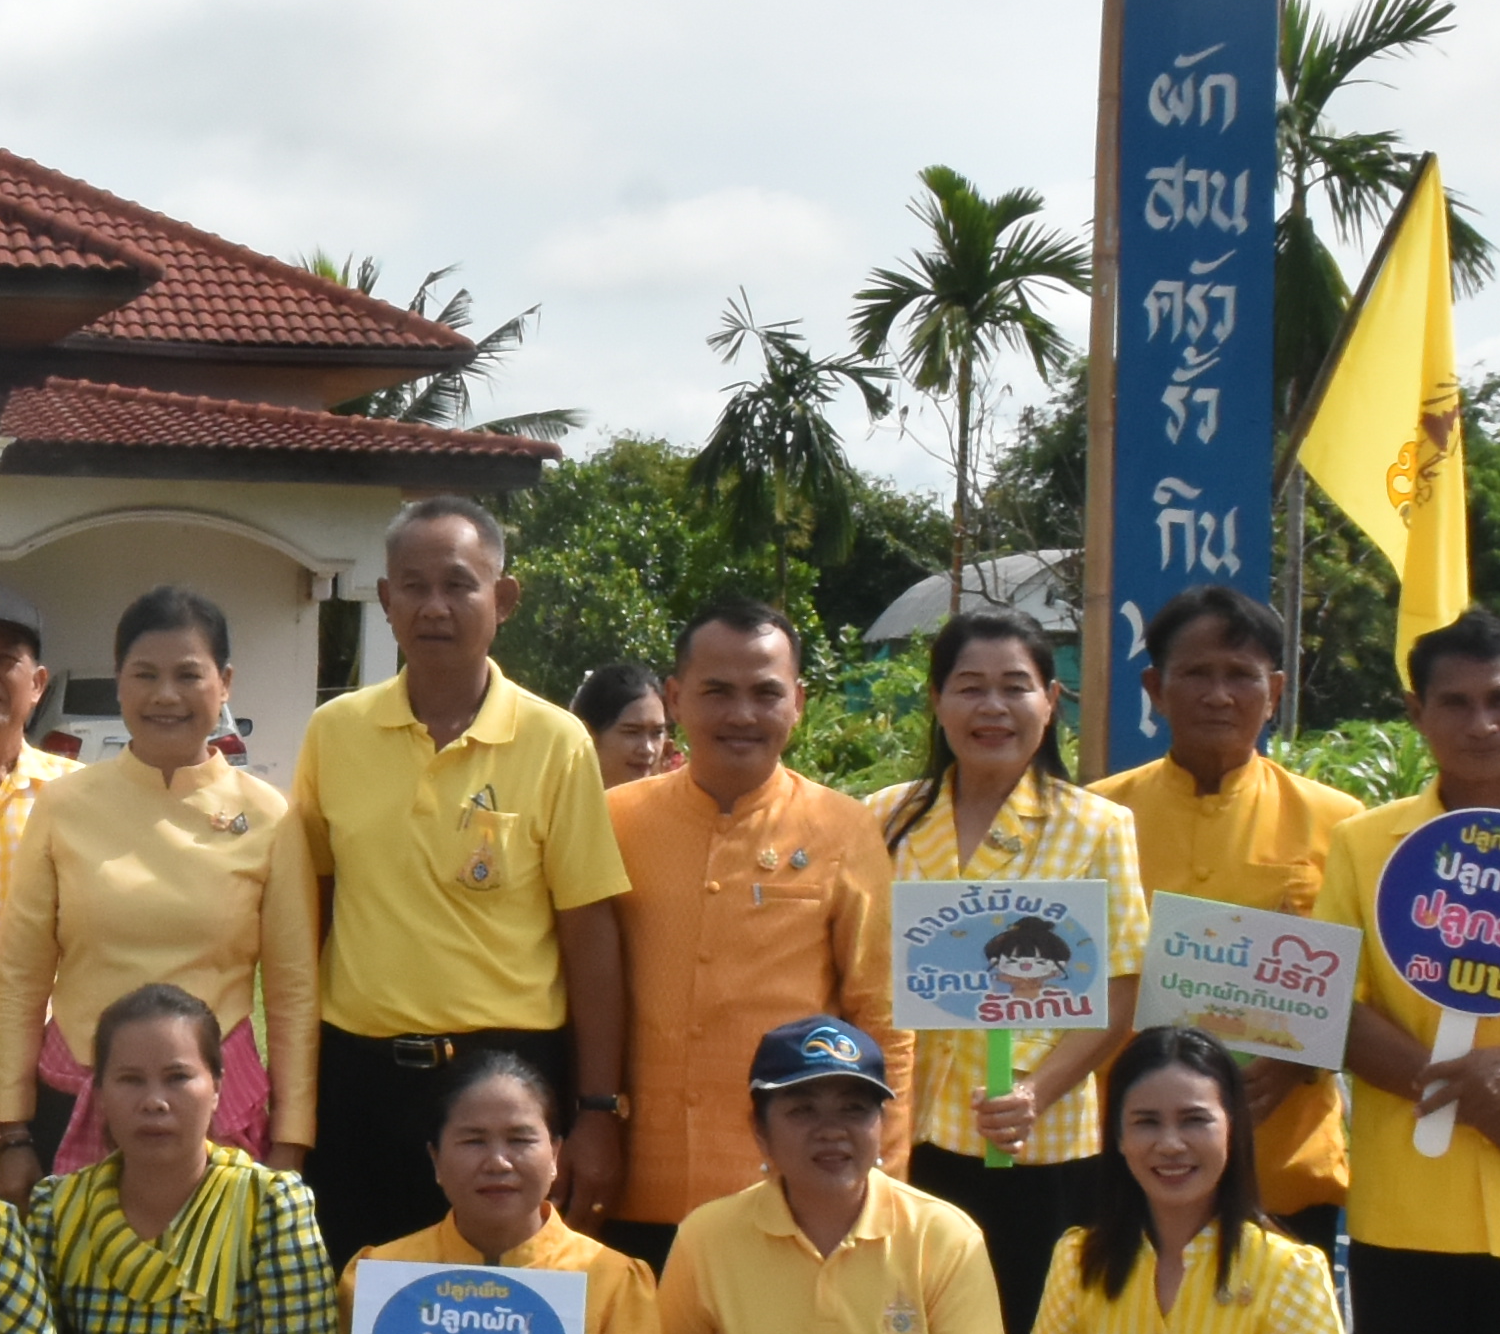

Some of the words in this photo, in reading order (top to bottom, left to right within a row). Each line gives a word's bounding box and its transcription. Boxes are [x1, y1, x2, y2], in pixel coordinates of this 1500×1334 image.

[1148, 41, 1238, 135] ผัก
[1143, 154, 1250, 236] สวน
[1142, 248, 1238, 345] ครัว
[1161, 346, 1222, 445] รั้ว
[1152, 476, 1242, 578] กิน
[903, 884, 1068, 945] ทางนี้มีผล
[906, 966, 990, 1001] ผู้คน
[1160, 971, 1329, 1021] ปลูกผักกินเอง
[1163, 930, 1255, 969] บ้านนี้
[1253, 956, 1328, 998] มีรัก
[1405, 954, 1442, 983] กับ
[977, 989, 1094, 1023] รักกัน
